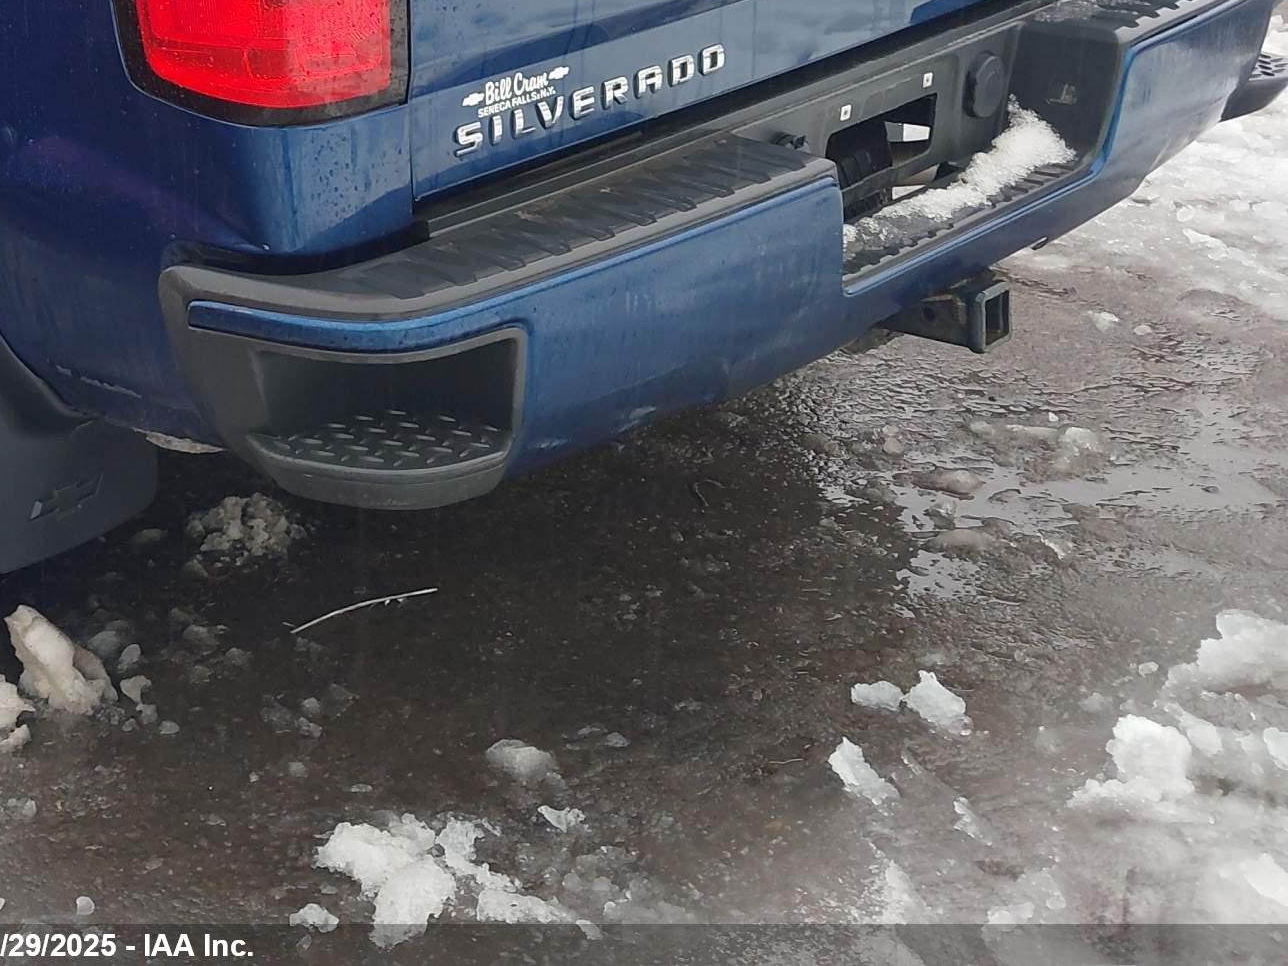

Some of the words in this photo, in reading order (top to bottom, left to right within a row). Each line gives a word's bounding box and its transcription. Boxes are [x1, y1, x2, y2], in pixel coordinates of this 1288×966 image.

[455, 43, 726, 157] SILVERADO
[485, 77, 512, 106] Bill
[478, 101, 512, 118] SENECA
